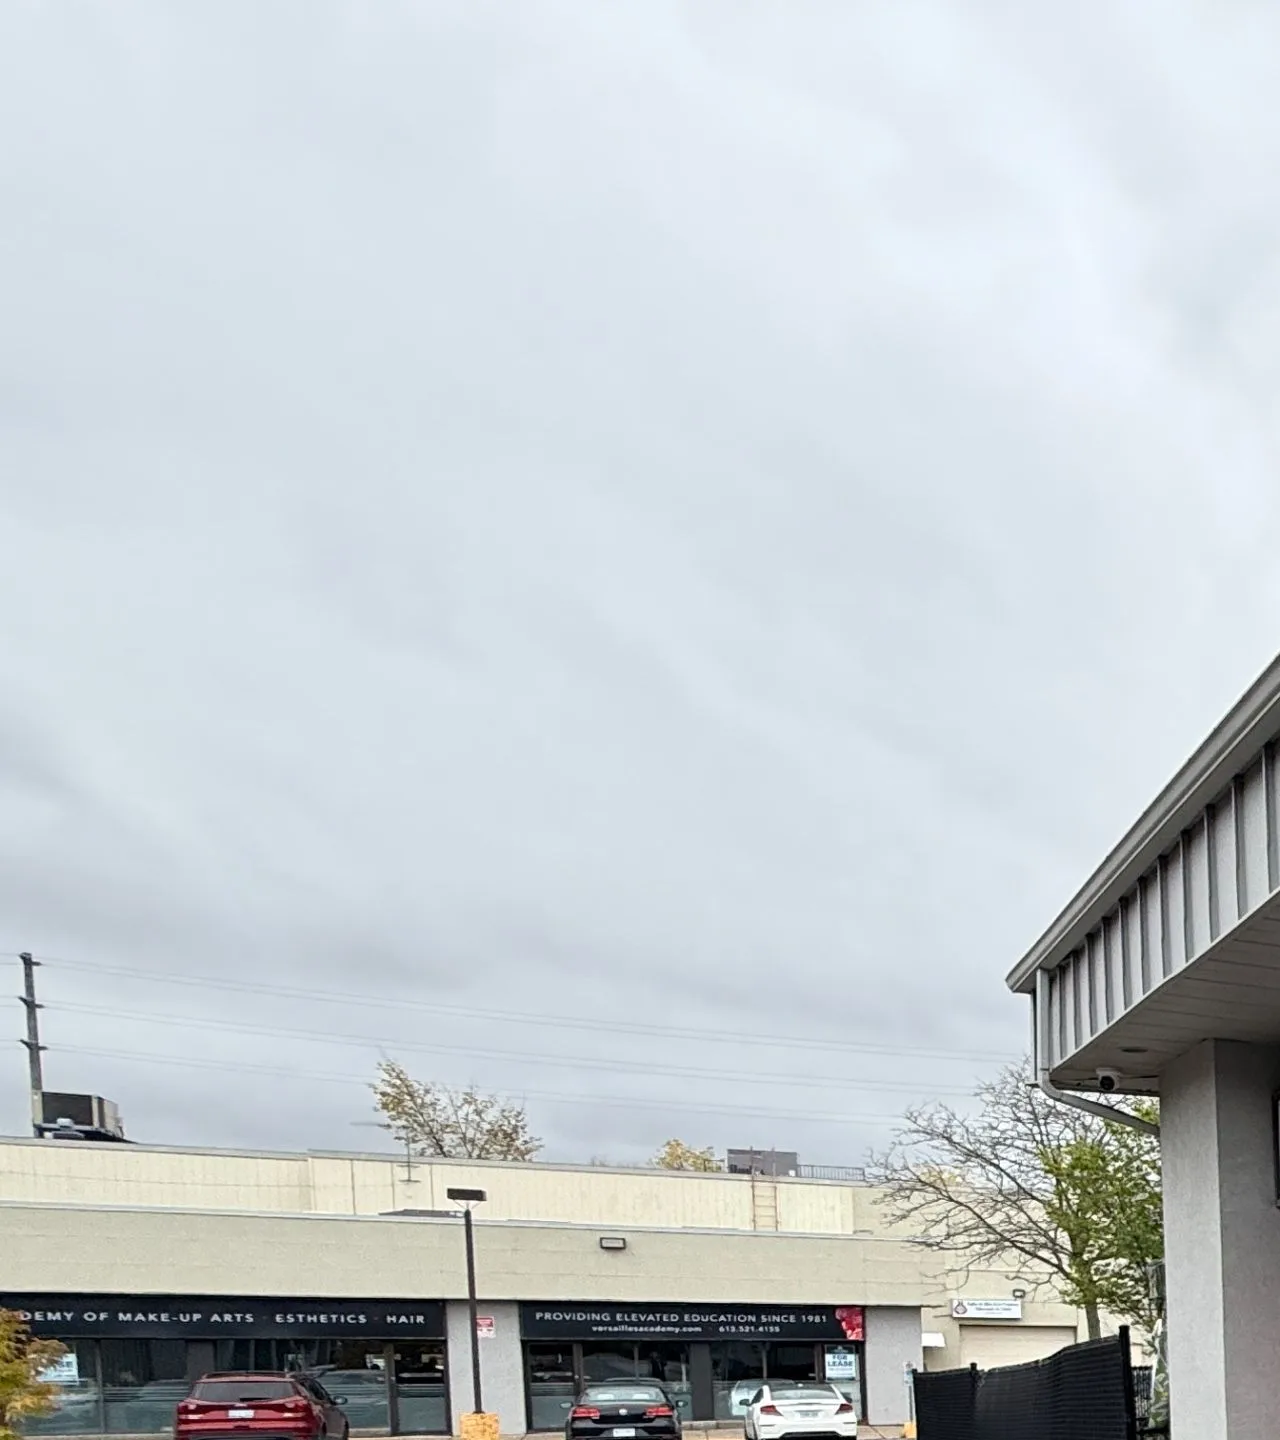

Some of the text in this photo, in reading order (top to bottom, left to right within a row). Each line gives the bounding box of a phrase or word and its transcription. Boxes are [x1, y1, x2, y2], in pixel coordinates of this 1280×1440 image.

[19, 1311, 426, 1325] DEMY OF MAKE-UP ARTS ESTHETICS HAIR
[535, 1312, 828, 1324] PROVIDING ELEVATED EDUCATION SINCE 1981
[591, 1324, 702, 1334] versaillesacademy.com
